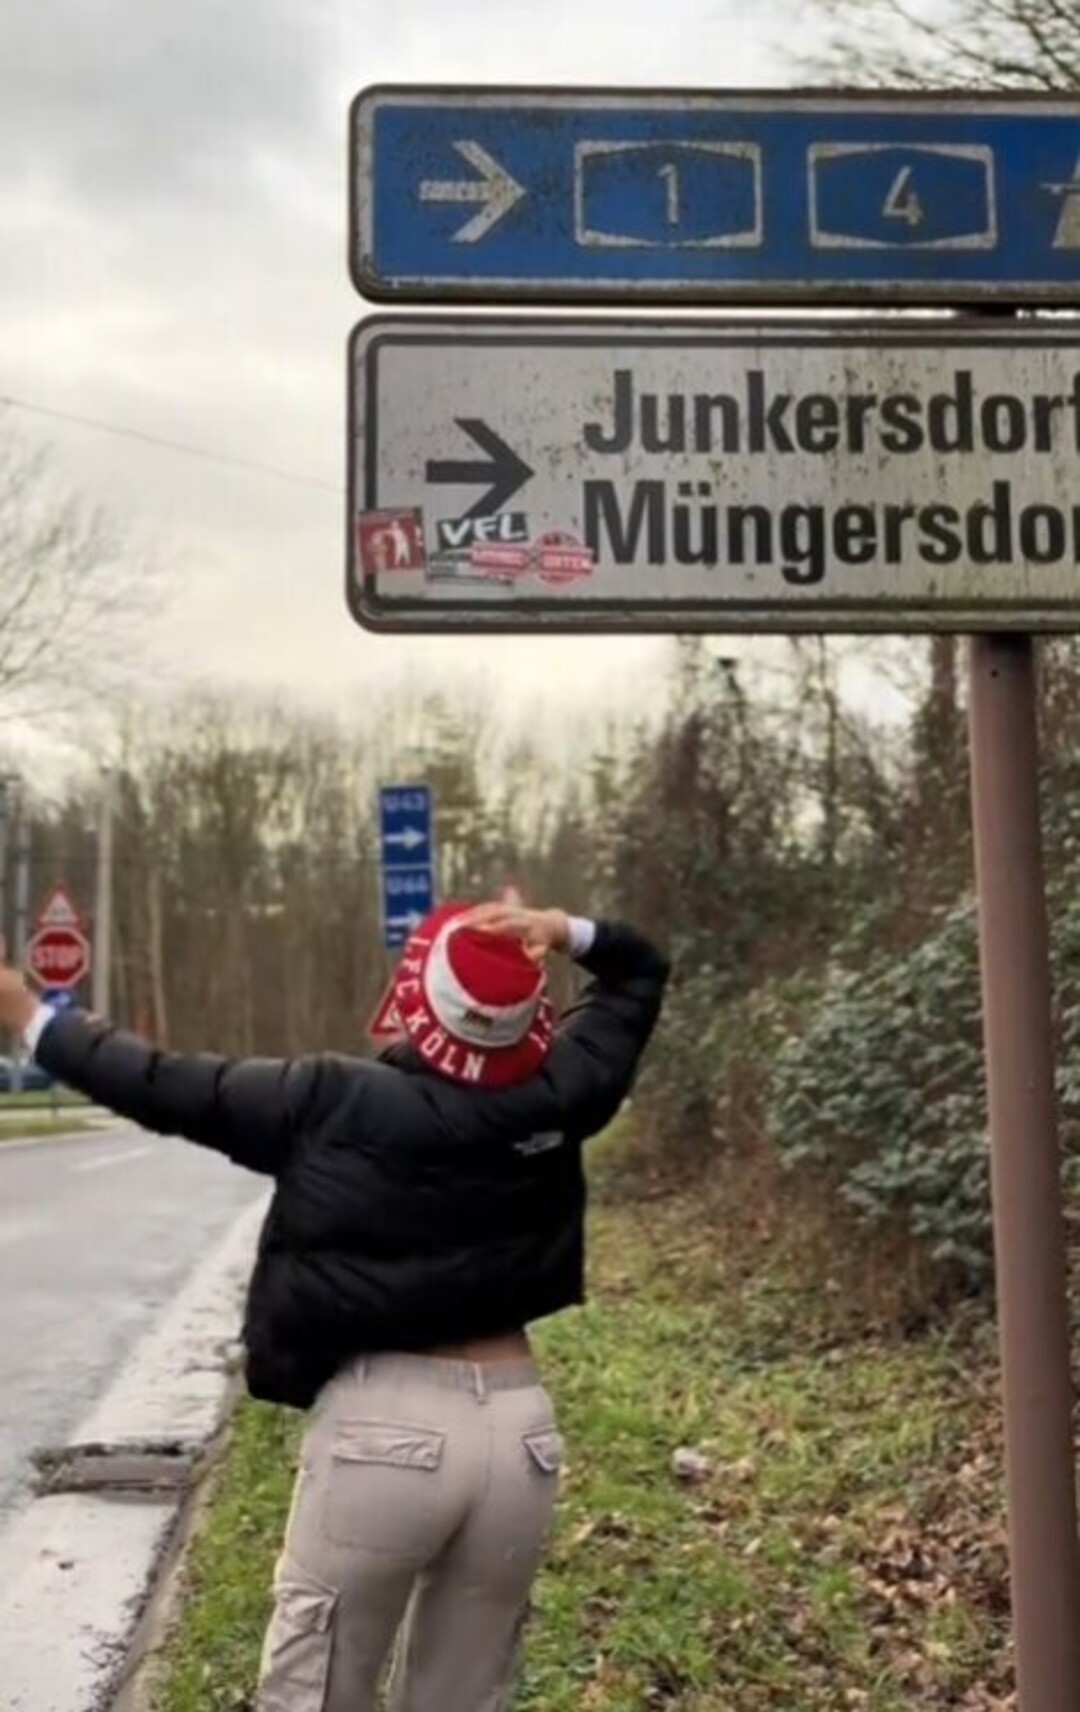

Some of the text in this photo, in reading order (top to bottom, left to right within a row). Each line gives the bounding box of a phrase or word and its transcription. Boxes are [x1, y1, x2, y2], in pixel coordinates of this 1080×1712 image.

[658, 163, 923, 225] 1 4
[583, 479, 1080, 585] Müngersdo
[34, 944, 82, 969] STOP
